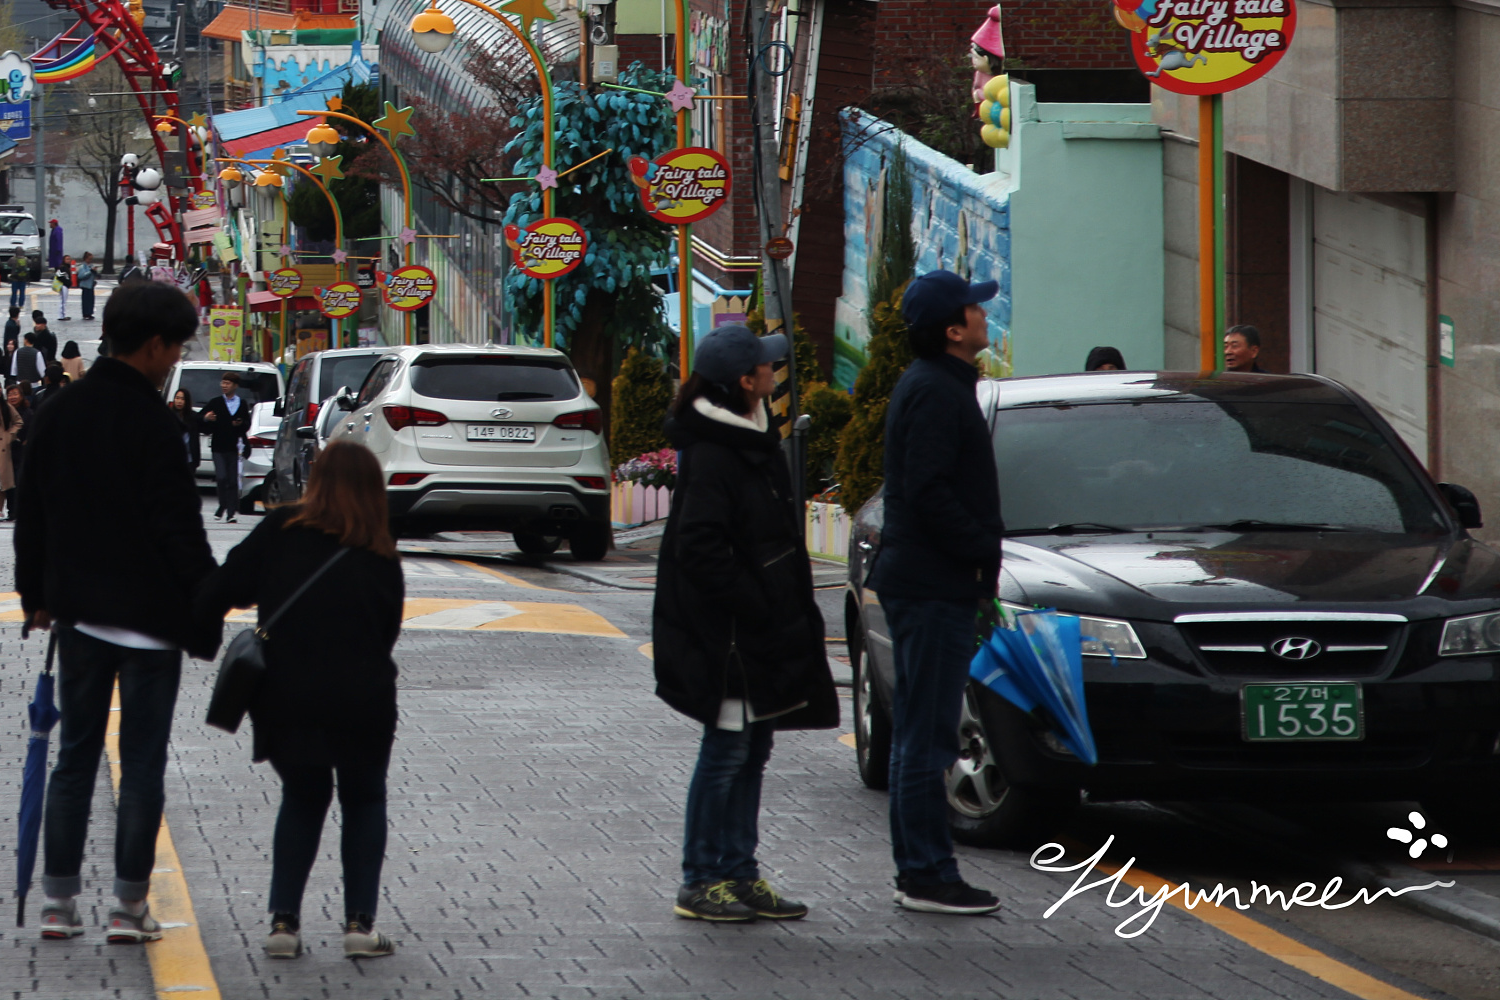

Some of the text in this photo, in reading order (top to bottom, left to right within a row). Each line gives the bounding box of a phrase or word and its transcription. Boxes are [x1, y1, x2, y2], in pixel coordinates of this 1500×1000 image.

[1175, 23, 1281, 60] Village
[650, 164, 726, 185] Fairy tale
[665, 184, 724, 204] Village
[521, 231, 582, 248] Fairy tale
[533, 246, 580, 264] Village
[388, 276, 434, 289] Fairy tale
[397, 287, 432, 300] Village
[500, 427, 529, 439] 0822
[1274, 686, 1329, 702] 27머
[1258, 703, 1356, 737] 1535
